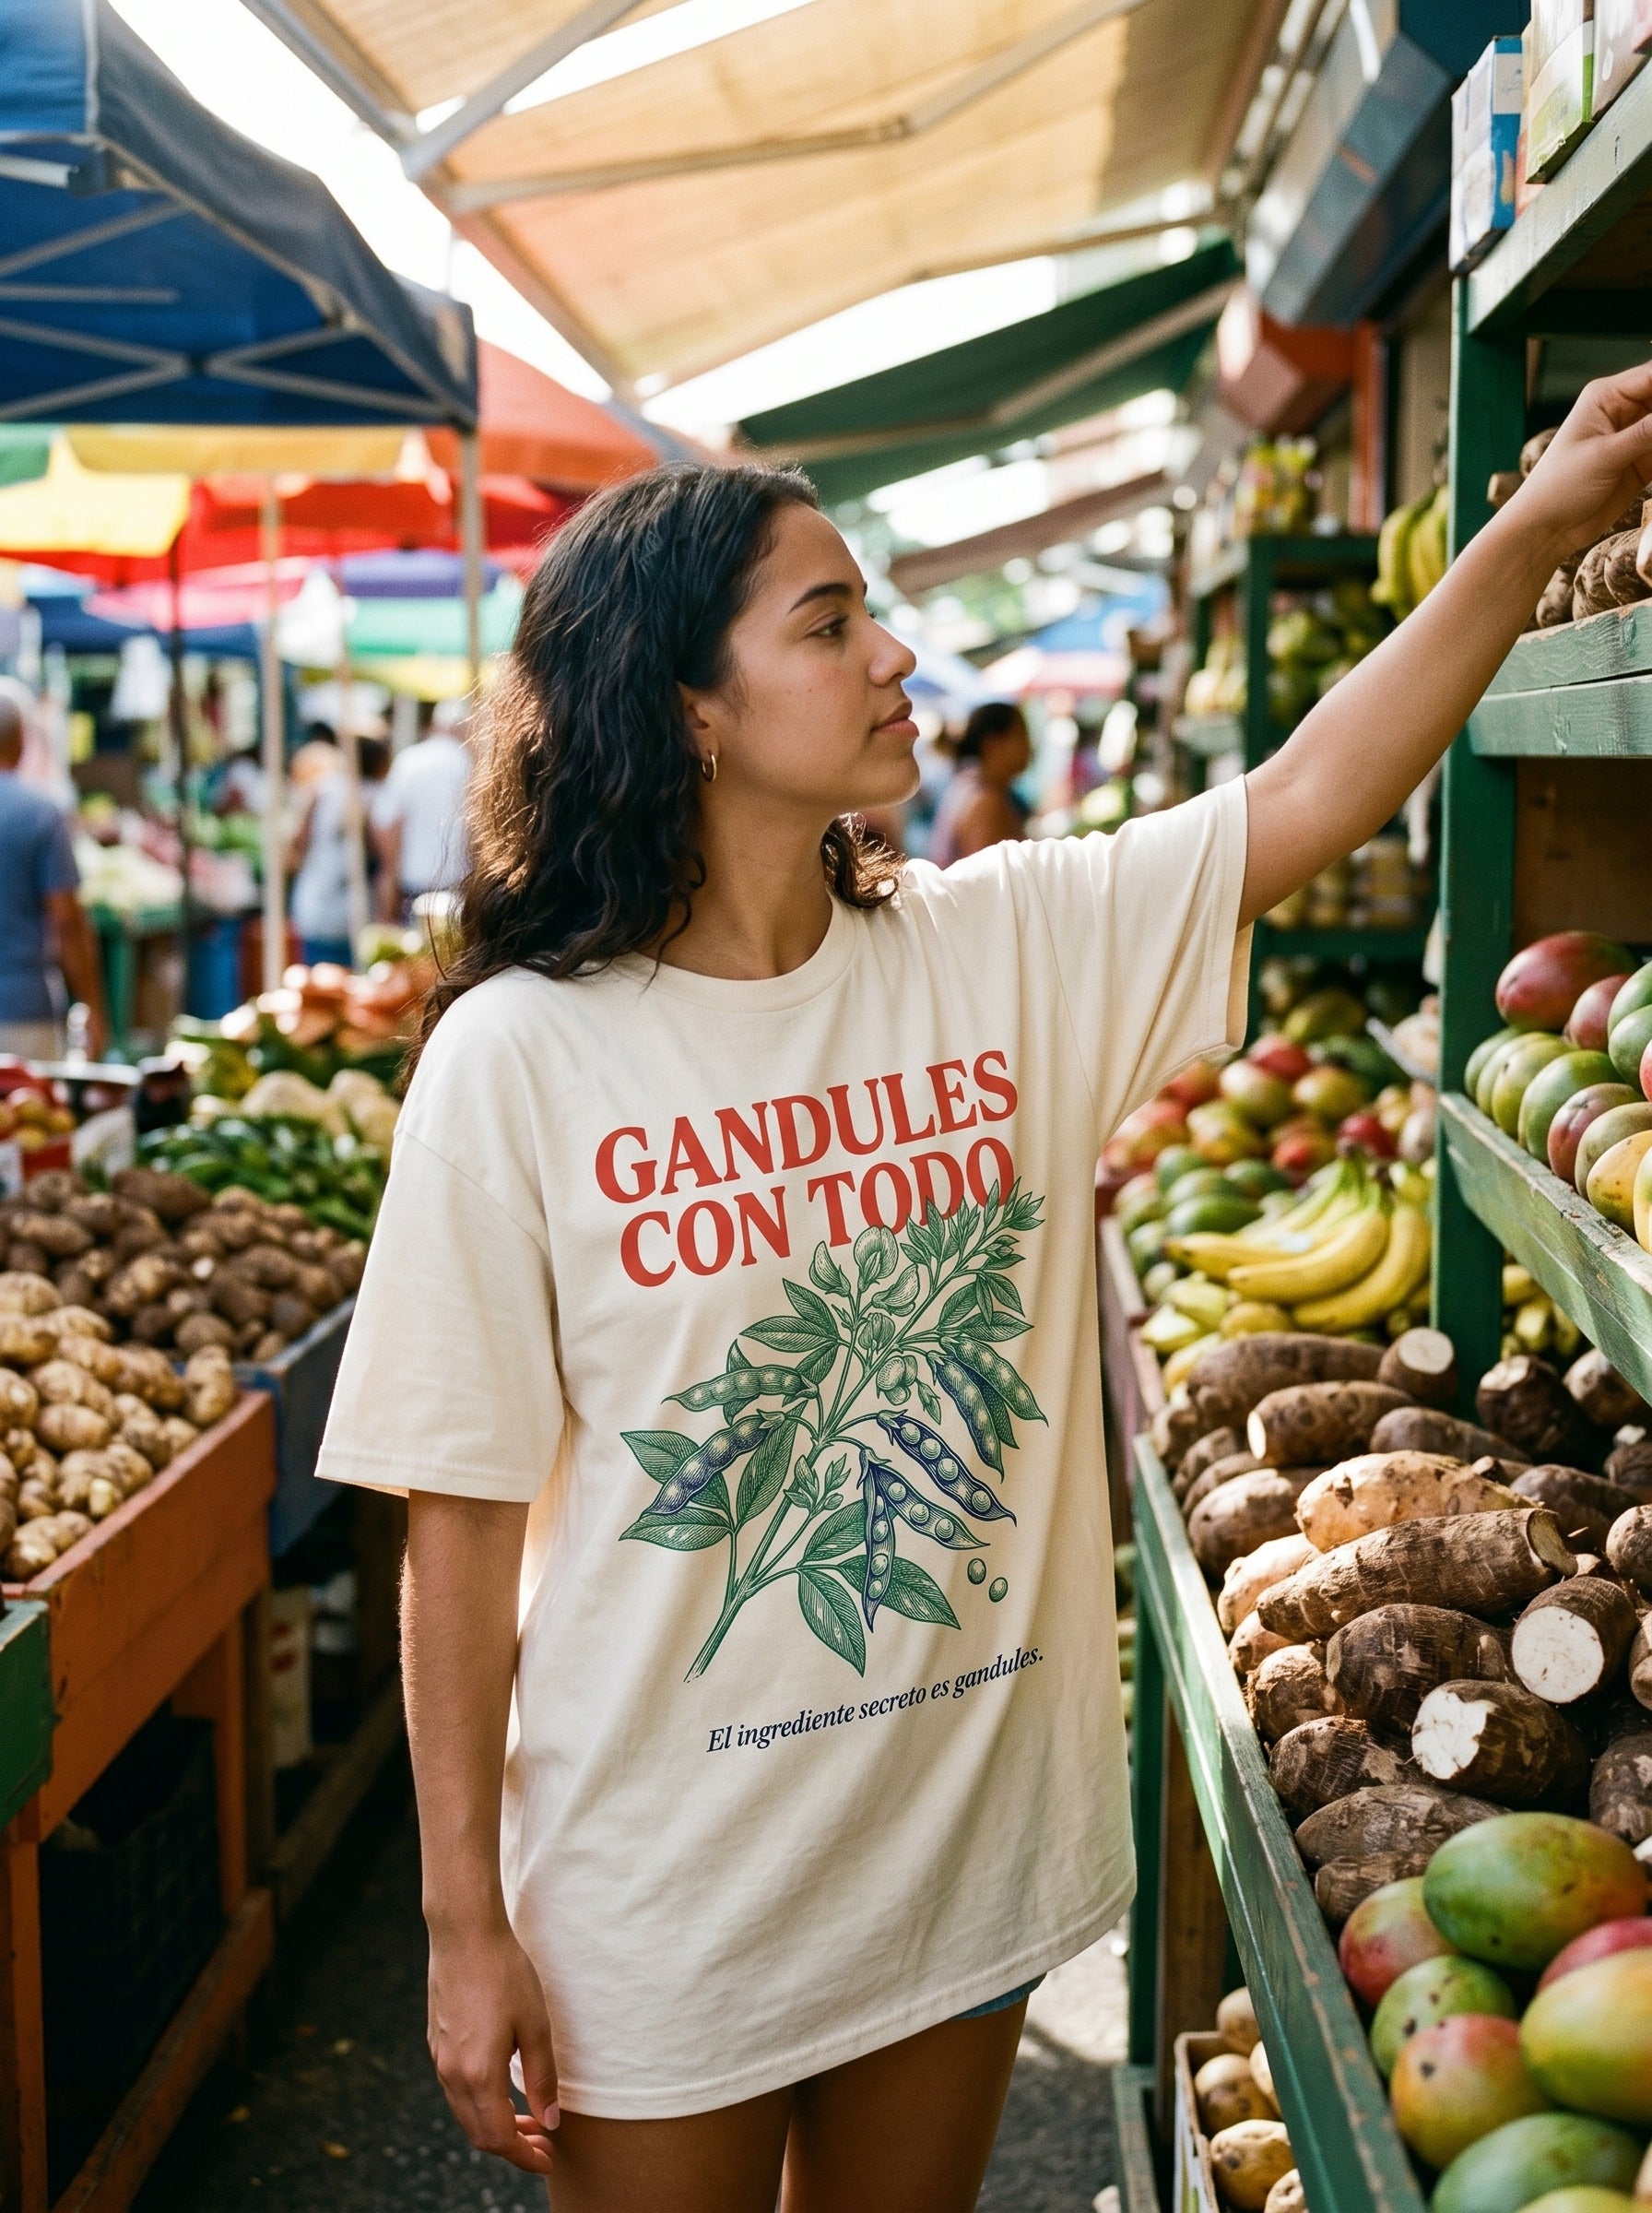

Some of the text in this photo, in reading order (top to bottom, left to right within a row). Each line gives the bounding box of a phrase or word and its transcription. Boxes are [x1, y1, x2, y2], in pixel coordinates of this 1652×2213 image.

[595, 1049, 1019, 1204] GANDULES
[620, 1136, 1016, 1288] CON TODO
[706, 1646, 1044, 1752] El ingrediente secreto es gandules.
